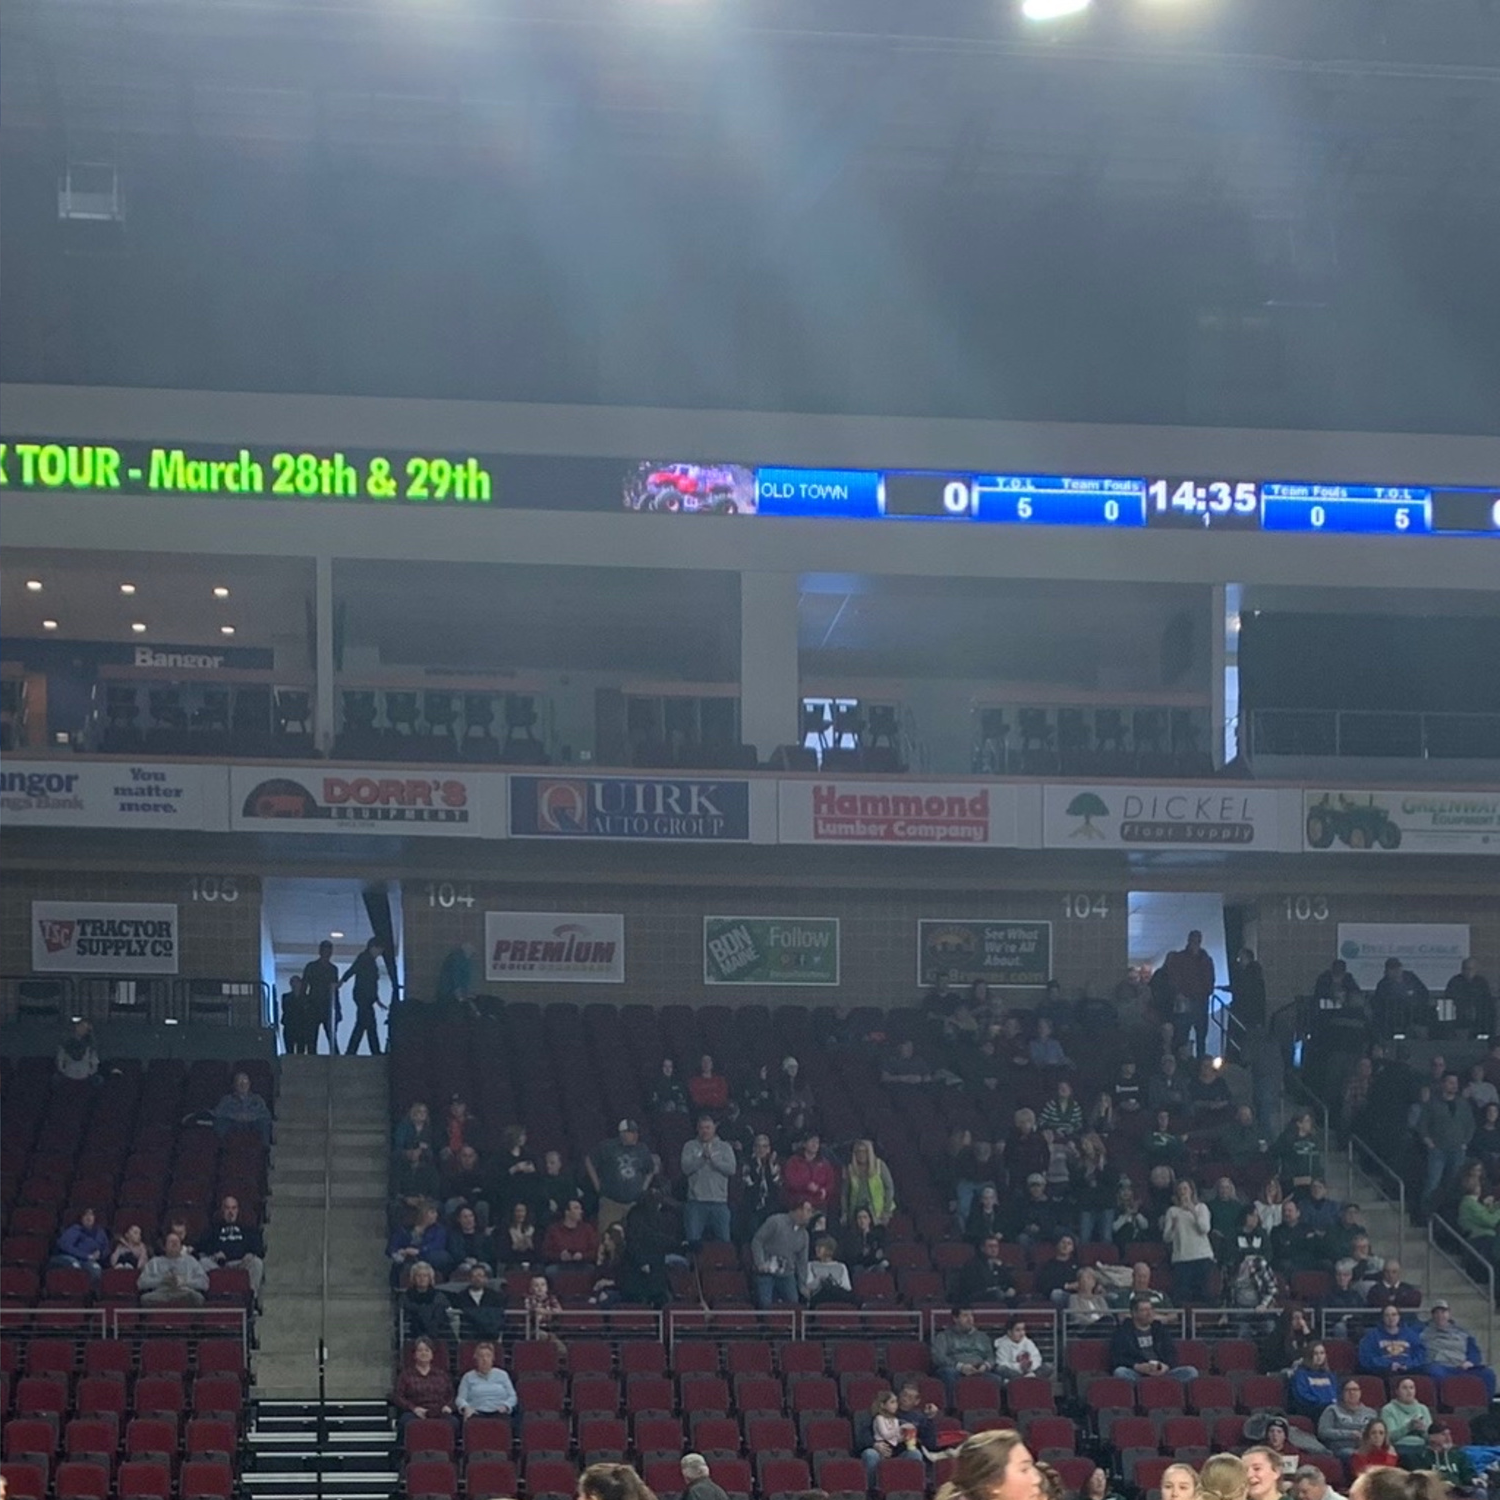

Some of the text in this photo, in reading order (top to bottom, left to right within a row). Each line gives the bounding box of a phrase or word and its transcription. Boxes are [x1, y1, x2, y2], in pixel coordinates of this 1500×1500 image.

[15, 444, 120, 488] TOUR
[148, 448, 263, 493] March
[272, 452, 357, 496] 28th
[366, 456, 397, 499] &
[406, 457, 491, 501] 29th
[761, 482, 848, 500] OLD TOWN
[1061, 477, 1139, 491] Team Fouls
[1271, 484, 1347, 498] Team Fouls
[943, 481, 969, 512] 0
[1150, 480, 1256, 512] 14:35
[1017, 497, 1032, 518] 5
[1104, 500, 1119, 521] 0
[1310, 505, 1325, 527] 0
[1395, 508, 1410, 529] 5
[134, 647, 224, 669] Bangor
[130, 768, 167, 782] You
[114, 784, 183, 798] matter
[322, 777, 468, 808] DORR'S
[812, 785, 990, 817] Hammond
[330, 808, 462, 822] EQUIPMENT
[1123, 795, 1255, 821] DICKEL
[595, 817, 725, 836] AUTO GROUP
[818, 820, 984, 841] Lumber Company
[1123, 825, 1250, 840] Floor Supply
[1063, 894, 1109, 919] 104
[1283, 896, 1330, 921] 103
[76, 919, 172, 939] TRACTOR
[769, 926, 830, 948] Follow
[76, 938, 150, 957] SUPPLY
[492, 934, 616, 964] PREMIUM
